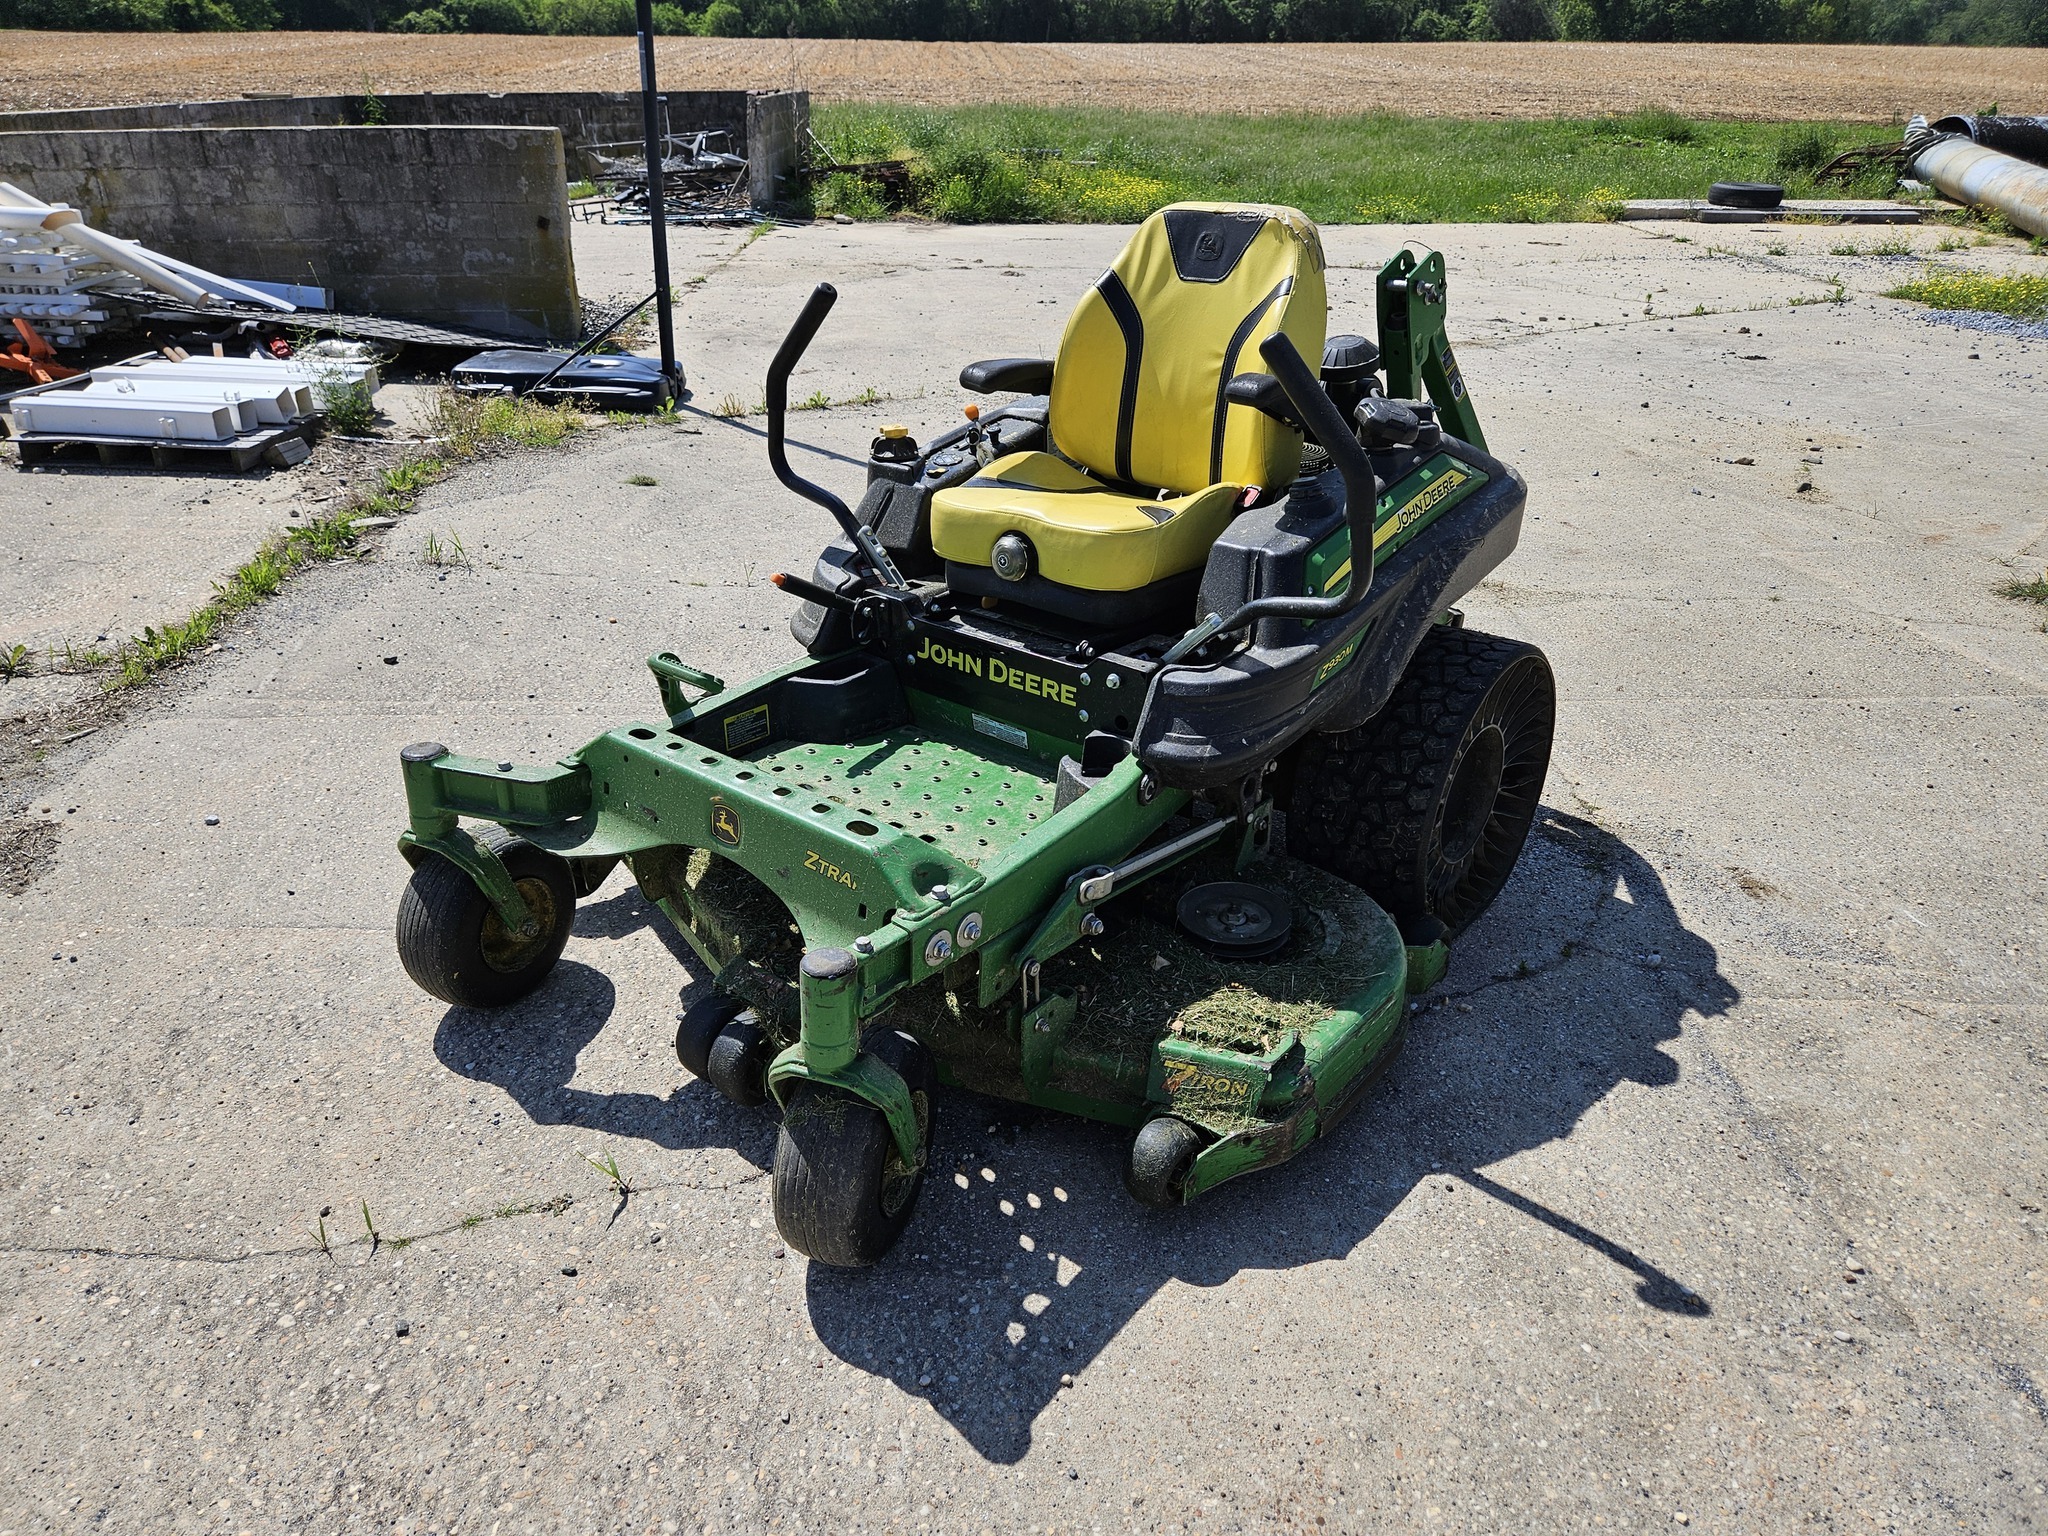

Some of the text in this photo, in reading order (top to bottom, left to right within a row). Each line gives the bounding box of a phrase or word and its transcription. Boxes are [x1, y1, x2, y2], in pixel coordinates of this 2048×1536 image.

[1396, 475, 1456, 532] JOHN DEERE
[917, 637, 1077, 707] JOHN DEERE
[1320, 643, 1354, 680] Z930M
